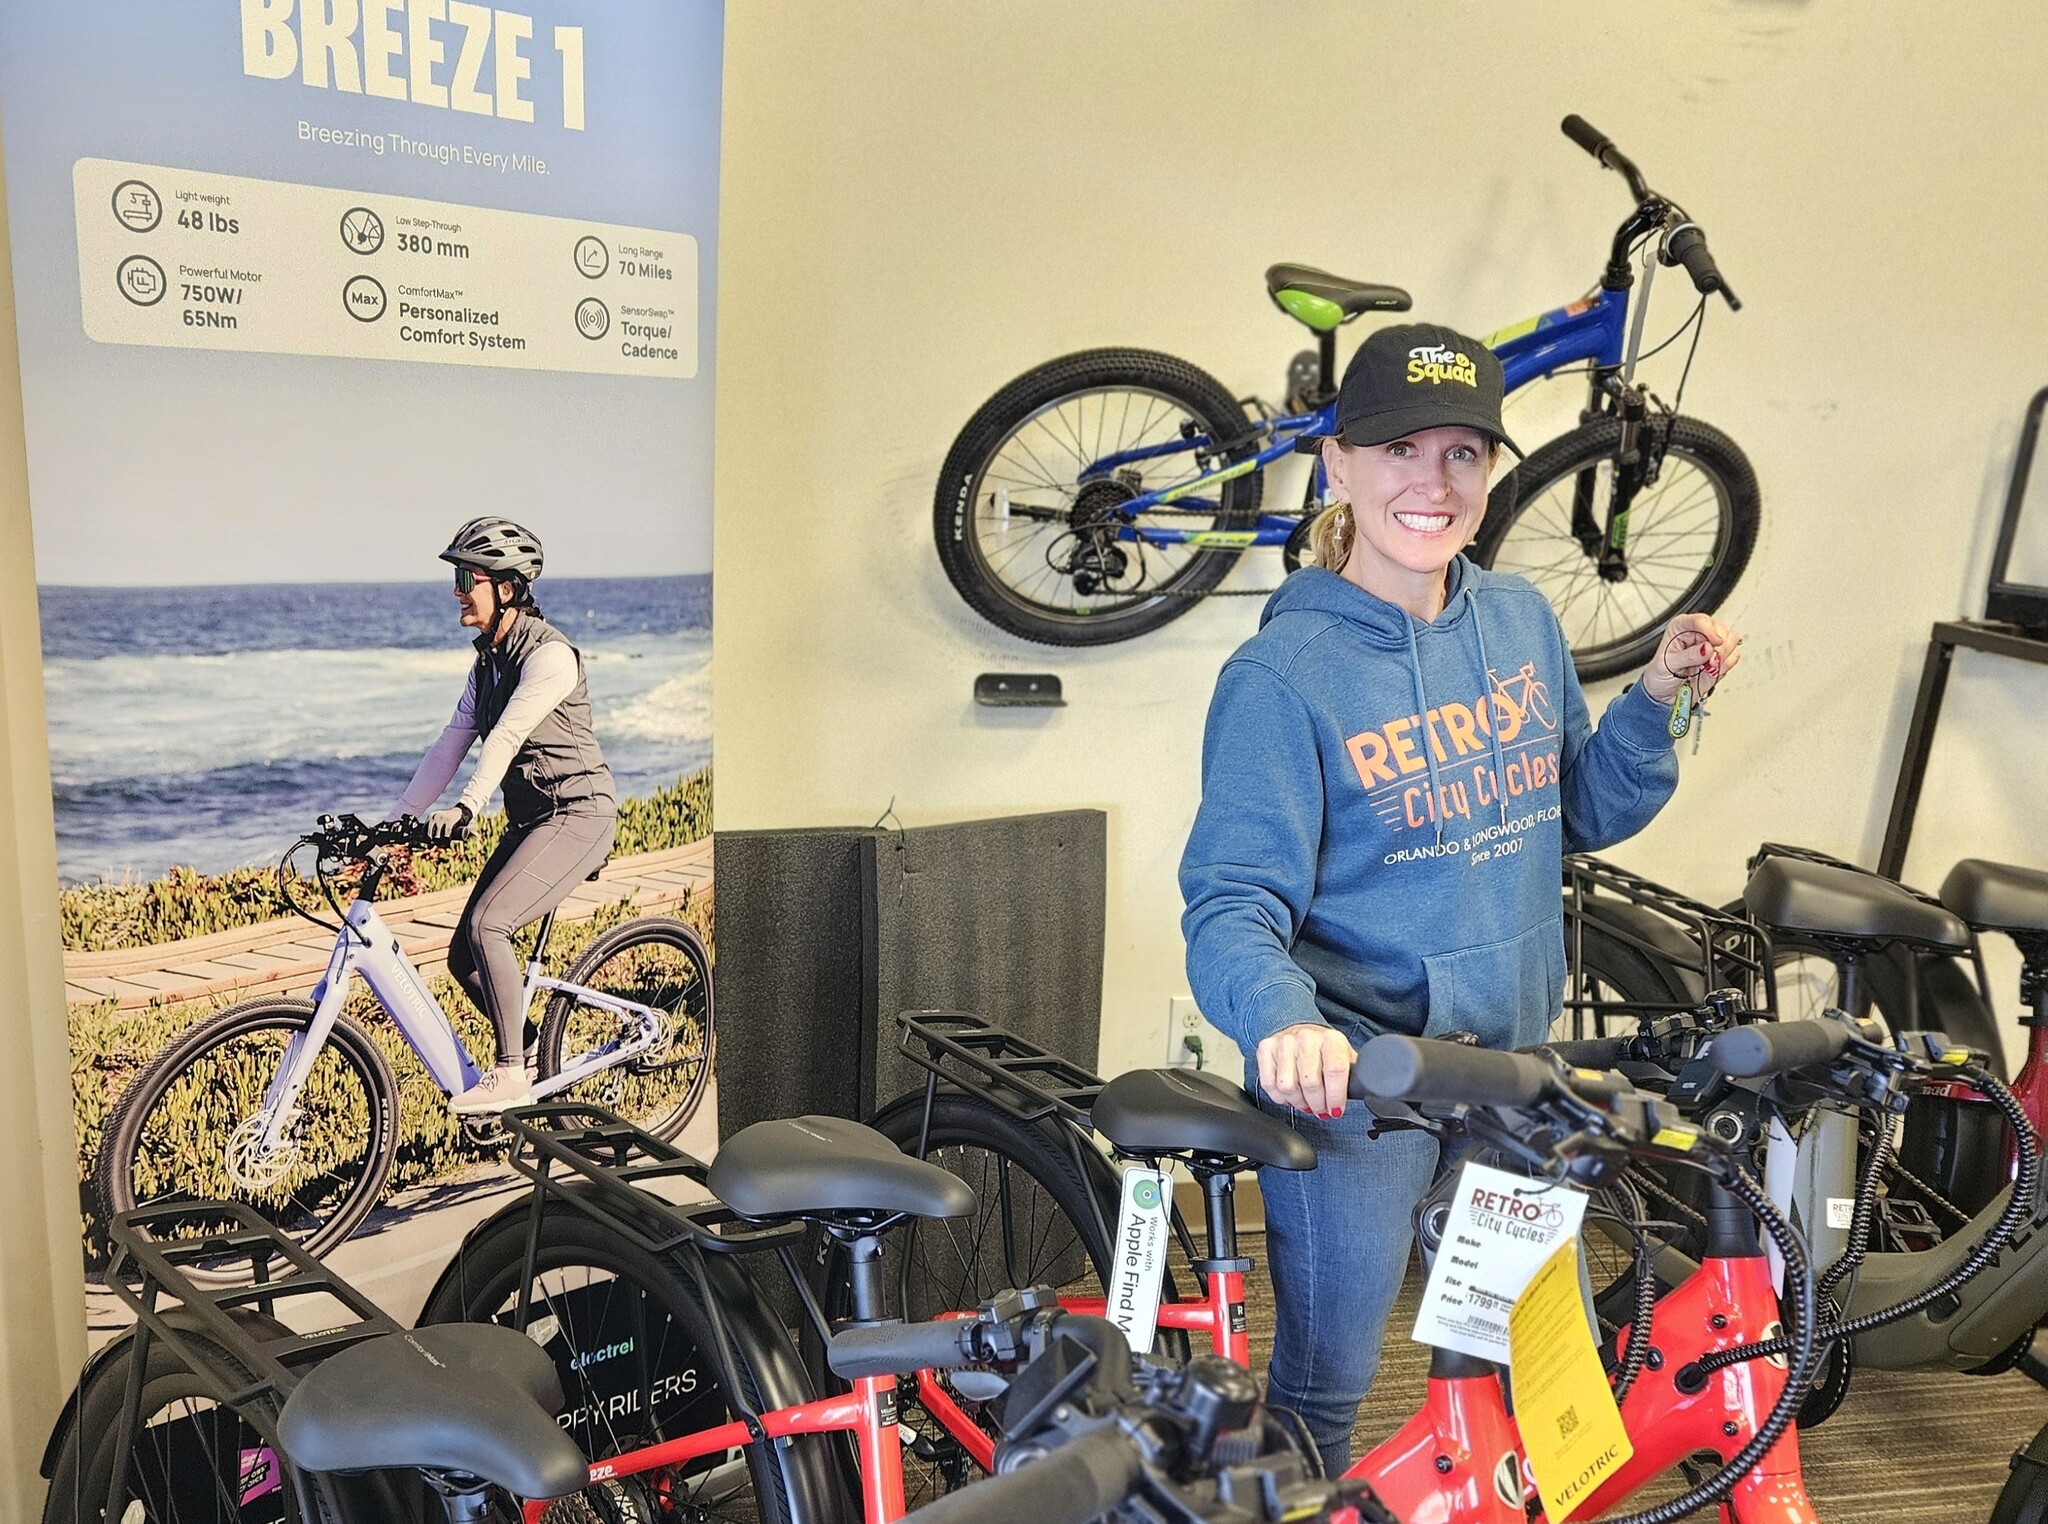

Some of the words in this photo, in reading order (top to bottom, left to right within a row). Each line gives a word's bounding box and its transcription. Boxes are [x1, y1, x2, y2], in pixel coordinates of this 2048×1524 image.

[241, 0, 534, 123] BREEZE
[555, 27, 584, 130] 1
[298, 121, 384, 155] Breezing
[388, 133, 460, 164] Through
[463, 147, 508, 173] Every
[512, 154, 550, 175] Mile.
[175, 190, 198, 203] Light
[200, 194, 230, 206] weight
[178, 209, 203, 230] 48
[209, 212, 240, 234] lbs
[396, 215, 412, 226] Low
[413, 217, 462, 233] Step-Through
[397, 233, 432, 254] 380
[437, 241, 469, 259] mm
[618, 244, 638, 258] Long
[640, 247, 663, 260] Range
[179, 265, 228, 279] Powerful
[230, 269, 262, 282] Motor
[619, 261, 636, 276] 70
[639, 263, 672, 280] Miles
[181, 284, 242, 304] 750W/
[351, 291, 379, 306] Max
[183, 309, 237, 329] 65Nm
[399, 302, 499, 325] Personalized
[400, 325, 465, 345] Comfort
[469, 331, 526, 351] System
[621, 321, 672, 341] Torque/
[621, 342, 678, 360] Cadence
[1408, 343, 1455, 364] The
[1406, 359, 1477, 388] Squad
[953, 473, 974, 542] KENDA
[1345, 692, 1522, 789] RETRO
[1404, 780, 1471, 828] City
[1384, 841, 1460, 865] ORLANDO
[1463, 838, 1471, 851] &
[1472, 814, 1536, 847] LONGWOOD,
[1493, 837, 1523, 857] 2007
[391, 964, 428, 1018] VELOTRIC
[380, 1098, 389, 1153] KENDA
[1471, 1188, 1541, 1221] RETRO
[1126, 1213, 1147, 1267] Apple
[1147, 1217, 1158, 1247] Works
[1476, 1213, 1501, 1234] City
[1505, 1218, 1545, 1244] Cycles
[1456, 1235, 1482, 1249] Make
[1144, 1249, 1153, 1272] with
[1450, 1255, 1479, 1270] Model
[1119, 1271, 1140, 1311] Find
[1440, 1293, 1464, 1307] Price
[1555, 1443, 1619, 1506] VELOTRIC
